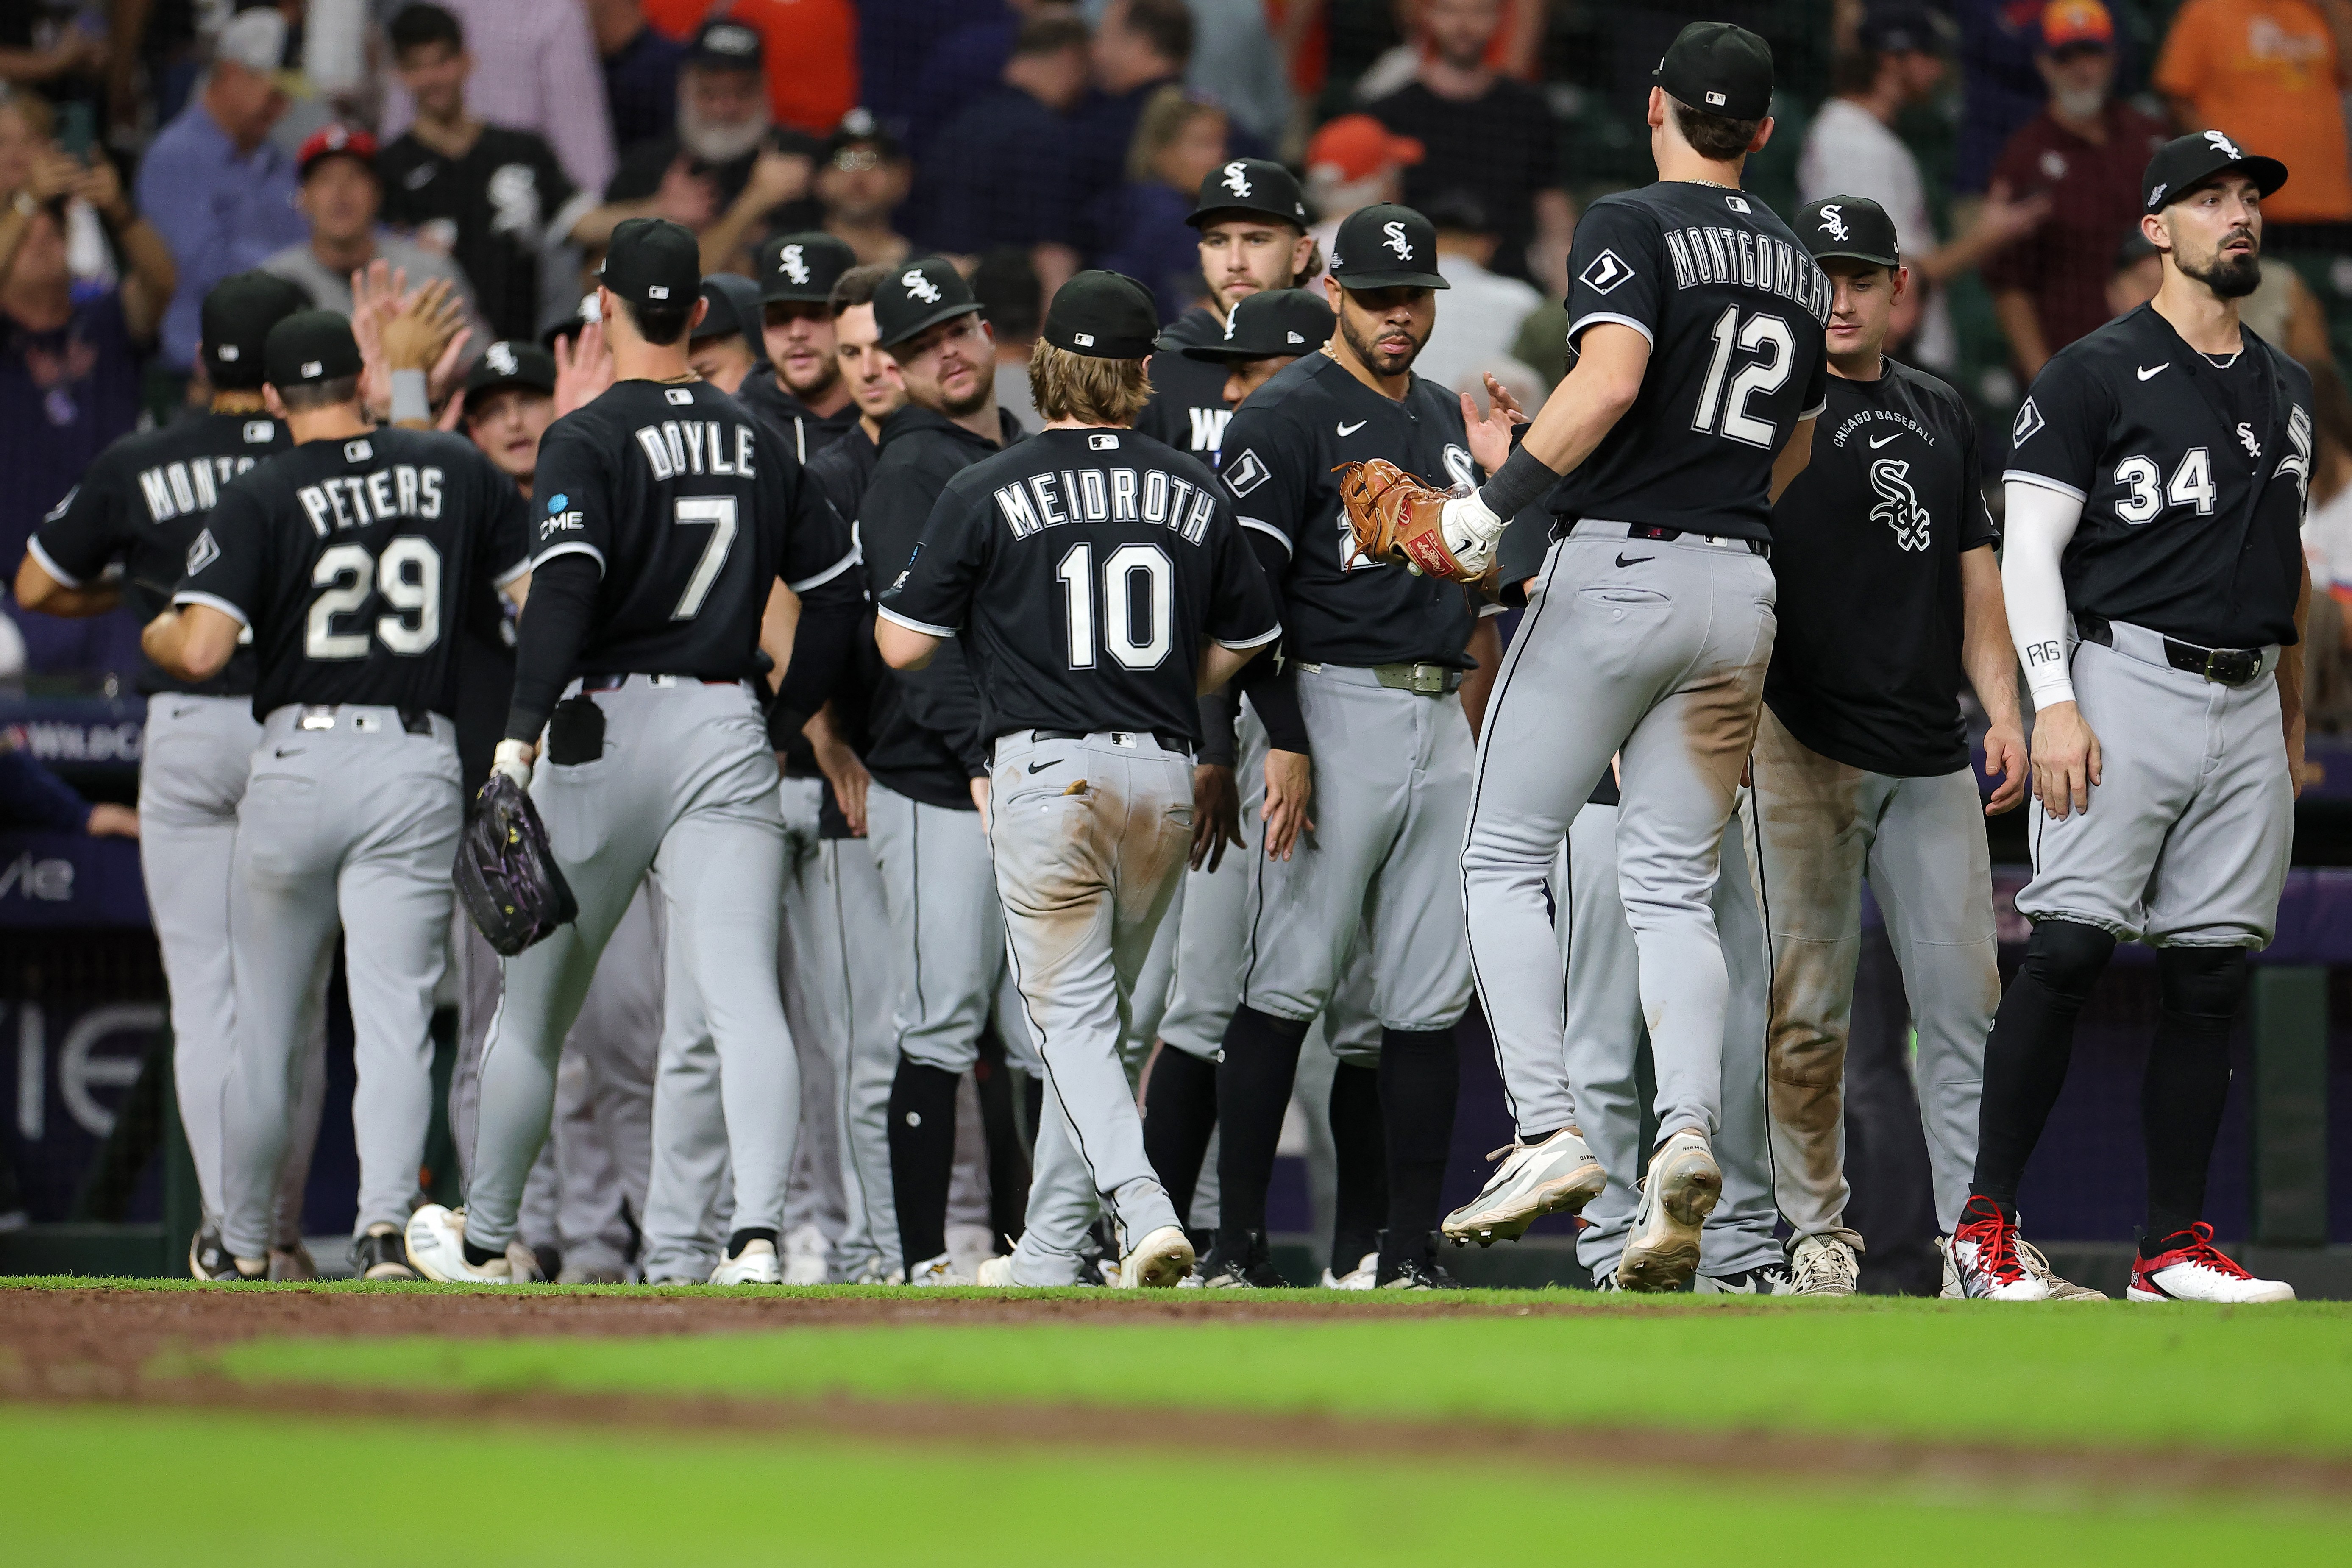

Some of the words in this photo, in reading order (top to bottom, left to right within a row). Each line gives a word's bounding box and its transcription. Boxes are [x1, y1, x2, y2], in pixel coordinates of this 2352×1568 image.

[1664, 226, 1834, 329] MONTGOMERY
[1690, 303, 1796, 450] 12
[635, 420, 757, 482] DOYLE
[1833, 410, 1872, 448] CHICAGO
[1874, 410, 1936, 447] BASEBALL
[297, 464, 445, 539] PETERS
[540, 511, 584, 538] CME
[993, 468, 1217, 547] MEIDROTH
[2113, 446, 2217, 525] 34
[669, 494, 739, 622] 7
[303, 534, 443, 663] 29
[1056, 542, 1175, 671] 10
